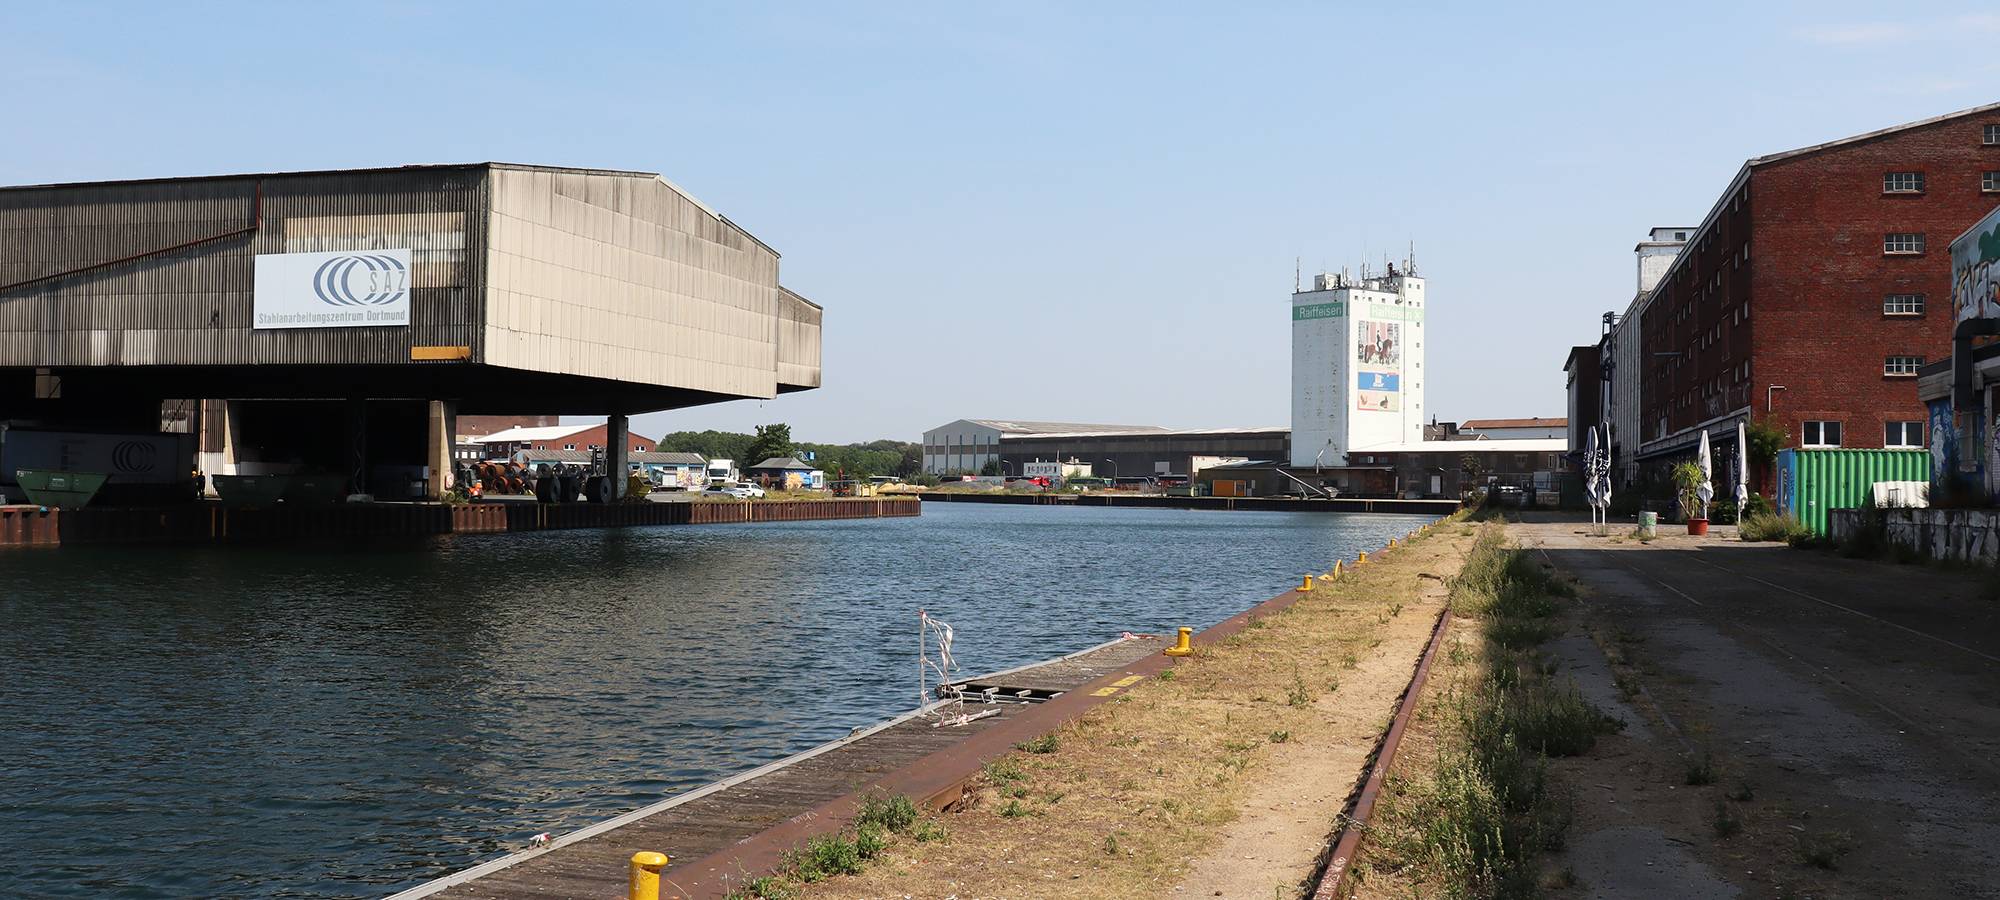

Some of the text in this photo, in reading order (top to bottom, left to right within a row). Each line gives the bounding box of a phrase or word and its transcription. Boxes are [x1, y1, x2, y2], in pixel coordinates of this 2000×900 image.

[369, 270, 406, 293] SAZ
[258, 309, 406, 324] Stahlanarbeitungszentrum Dortmund
[1299, 305, 1342, 318] Raiffeisen
